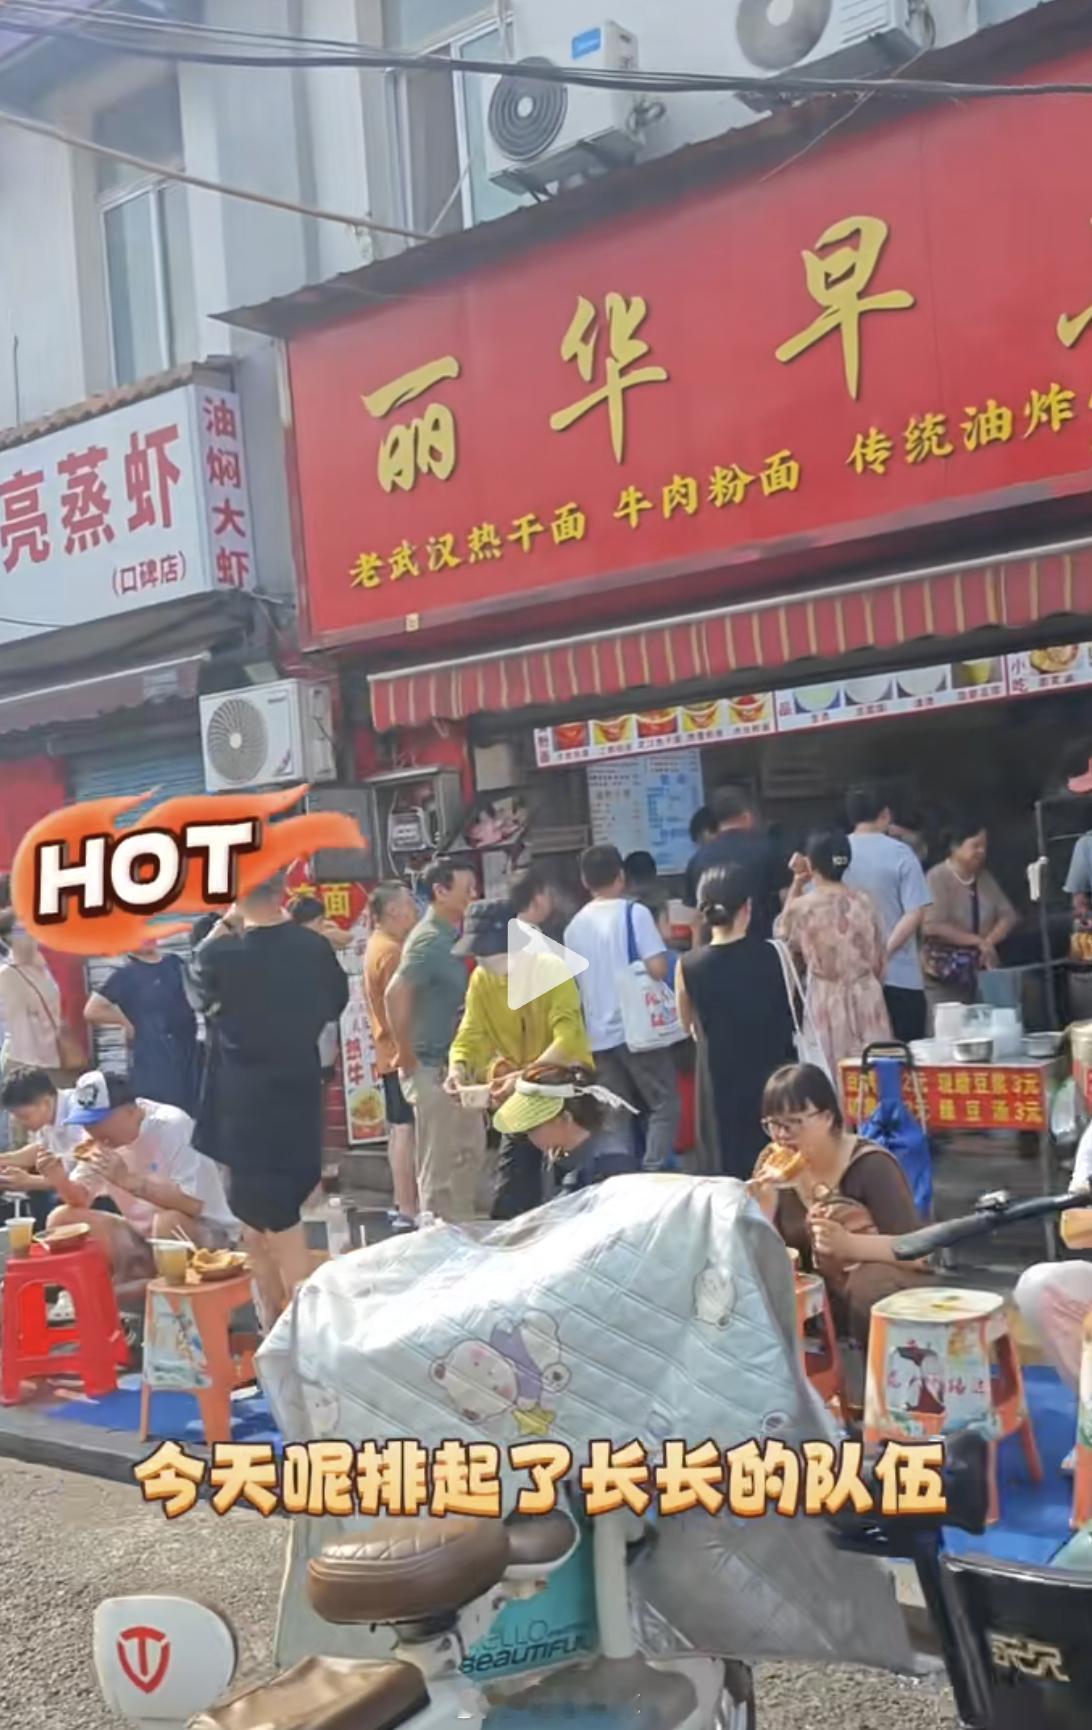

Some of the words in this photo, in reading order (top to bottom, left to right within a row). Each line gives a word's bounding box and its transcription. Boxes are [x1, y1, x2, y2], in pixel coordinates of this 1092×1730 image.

[361, 215, 1092, 493] 丽华早
[0, 423, 182, 574] 亮蒸虾
[202, 396, 250, 589] 油焖大虾
[348, 502, 586, 590] 老武汉热干面
[612, 450, 801, 530] 牛肉粉面
[846, 383, 1092, 476] 传统油炸
